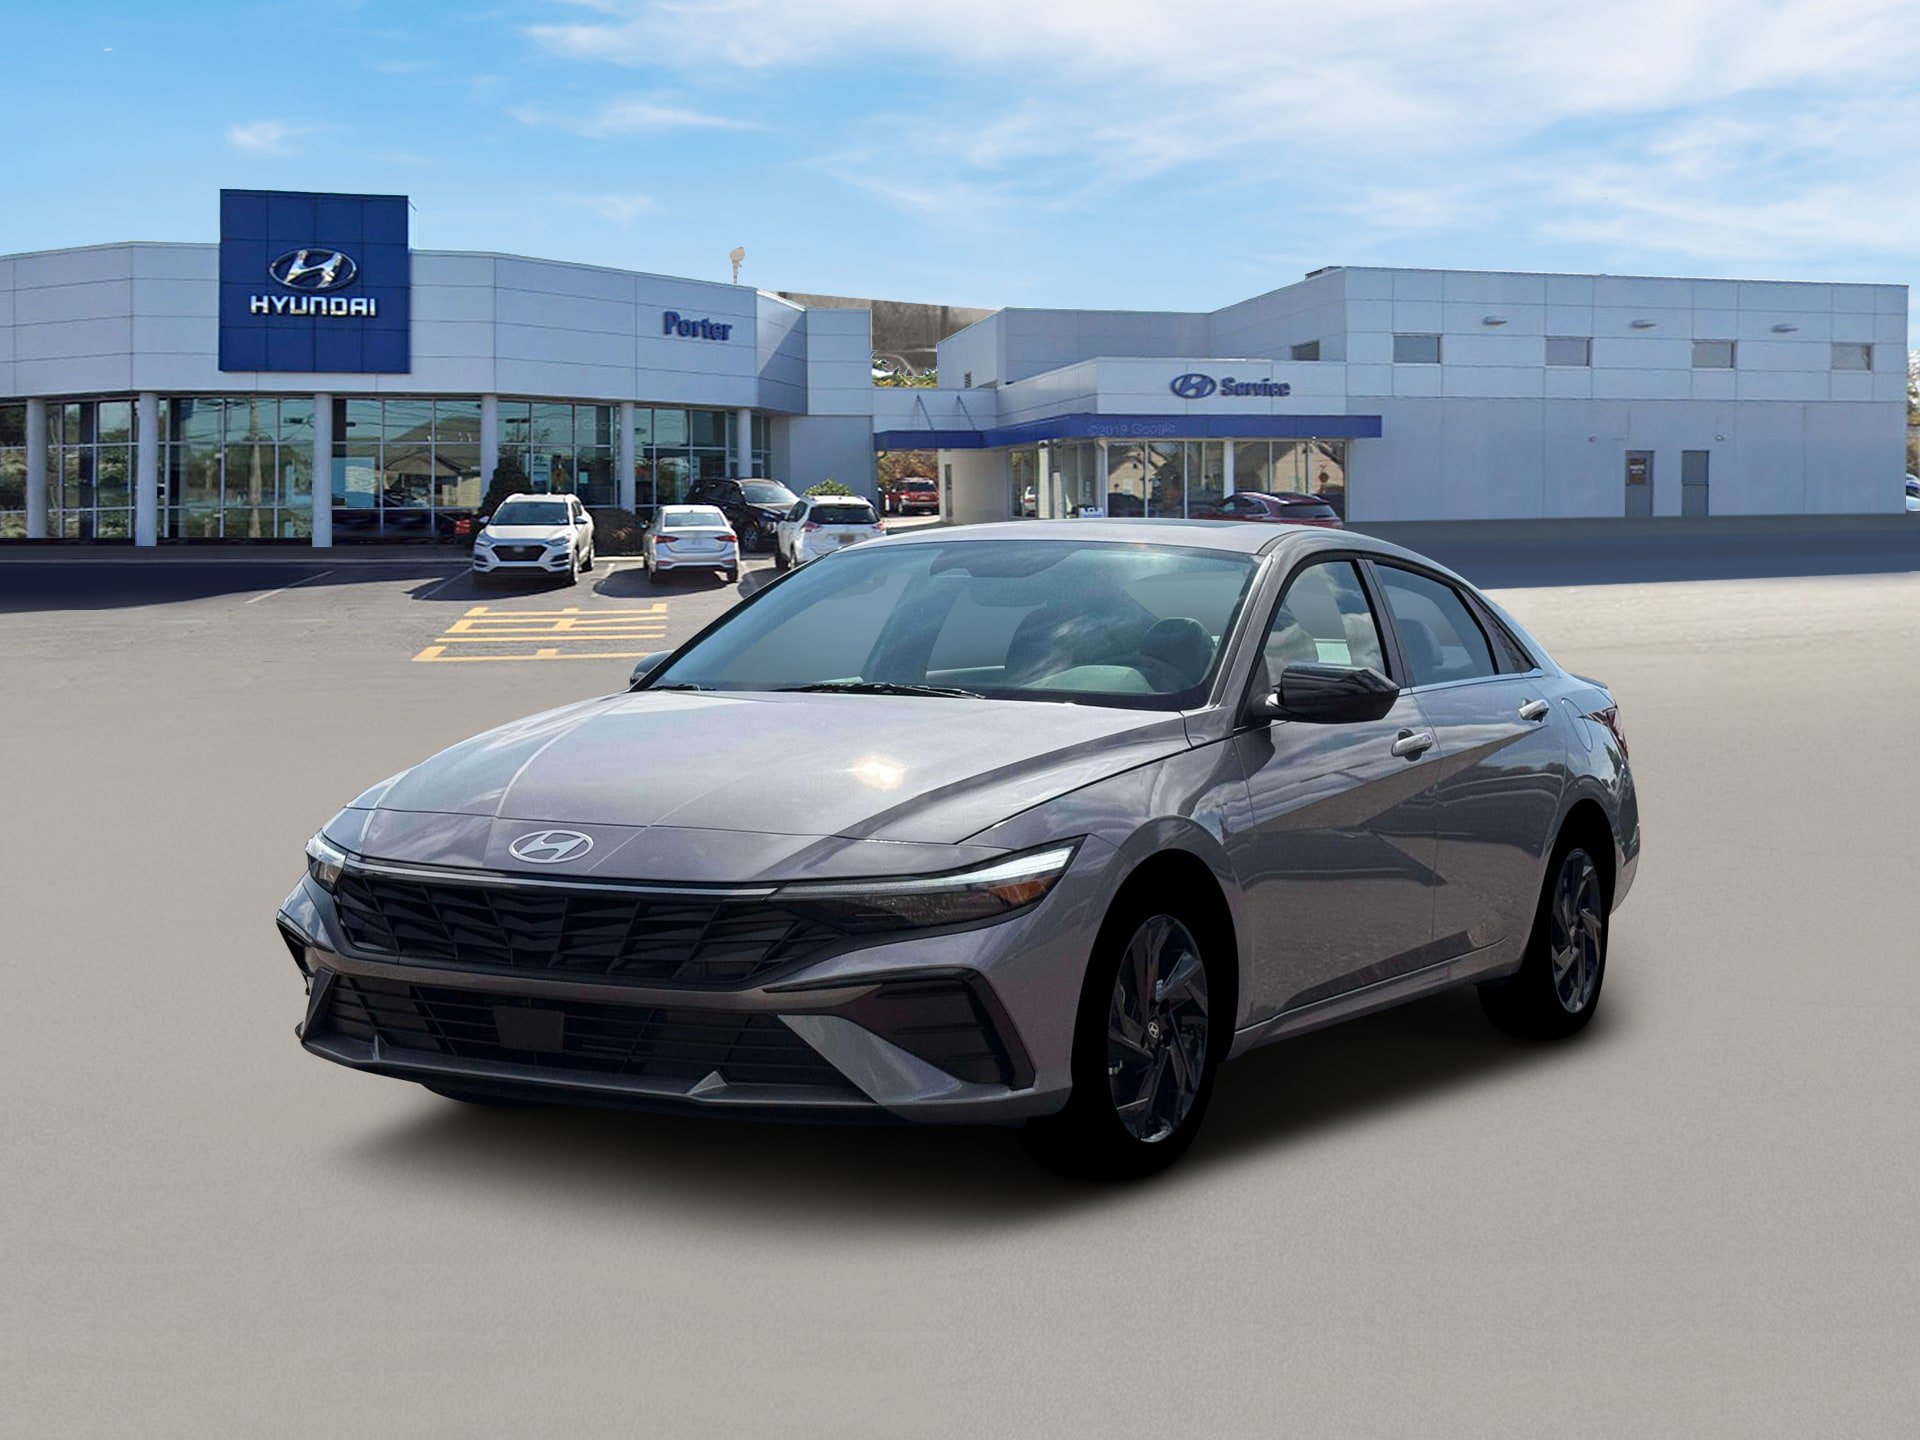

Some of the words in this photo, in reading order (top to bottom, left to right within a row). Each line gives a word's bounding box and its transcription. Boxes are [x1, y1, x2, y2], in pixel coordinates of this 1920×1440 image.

[250, 295, 377, 317] HYUNDAI
[663, 311, 733, 341] Porter
[1220, 377, 1291, 397] Service
